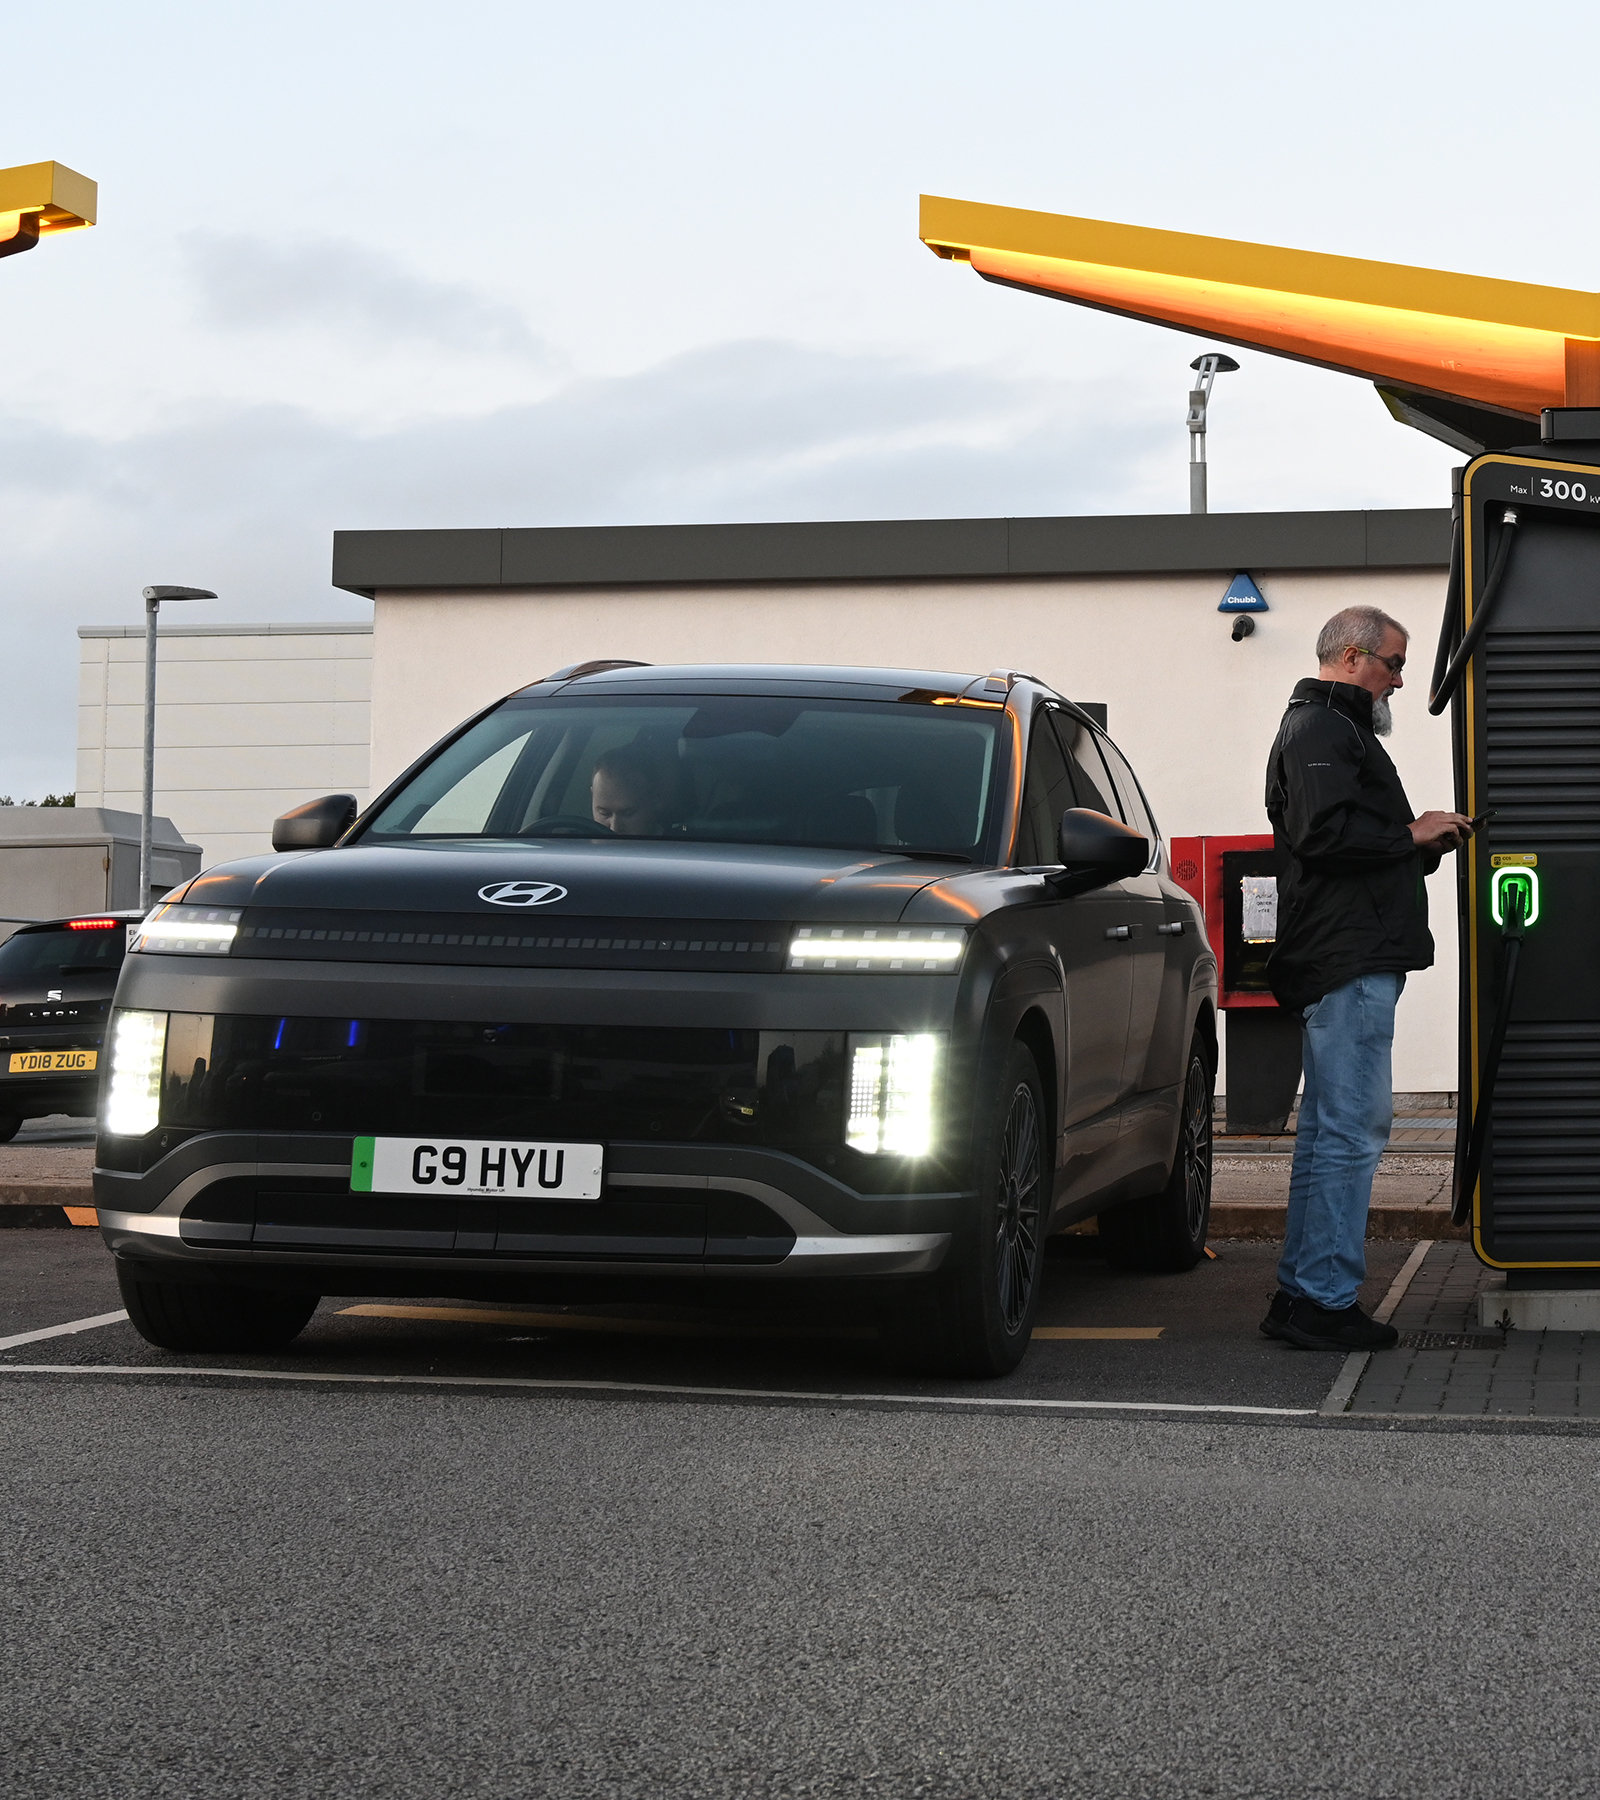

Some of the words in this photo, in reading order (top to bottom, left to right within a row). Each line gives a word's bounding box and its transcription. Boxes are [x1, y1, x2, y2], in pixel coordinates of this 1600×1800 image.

[1510, 485, 1528, 495] Max
[1540, 478, 1587, 502] 300
[1227, 596, 1257, 604] Chubb
[30, 1010, 78, 1018] LEON
[20, 1054, 52, 1069] YD18
[55, 1053, 86, 1068] ZUG
[412, 1145, 467, 1185] G9
[480, 1147, 564, 1189] HYU
